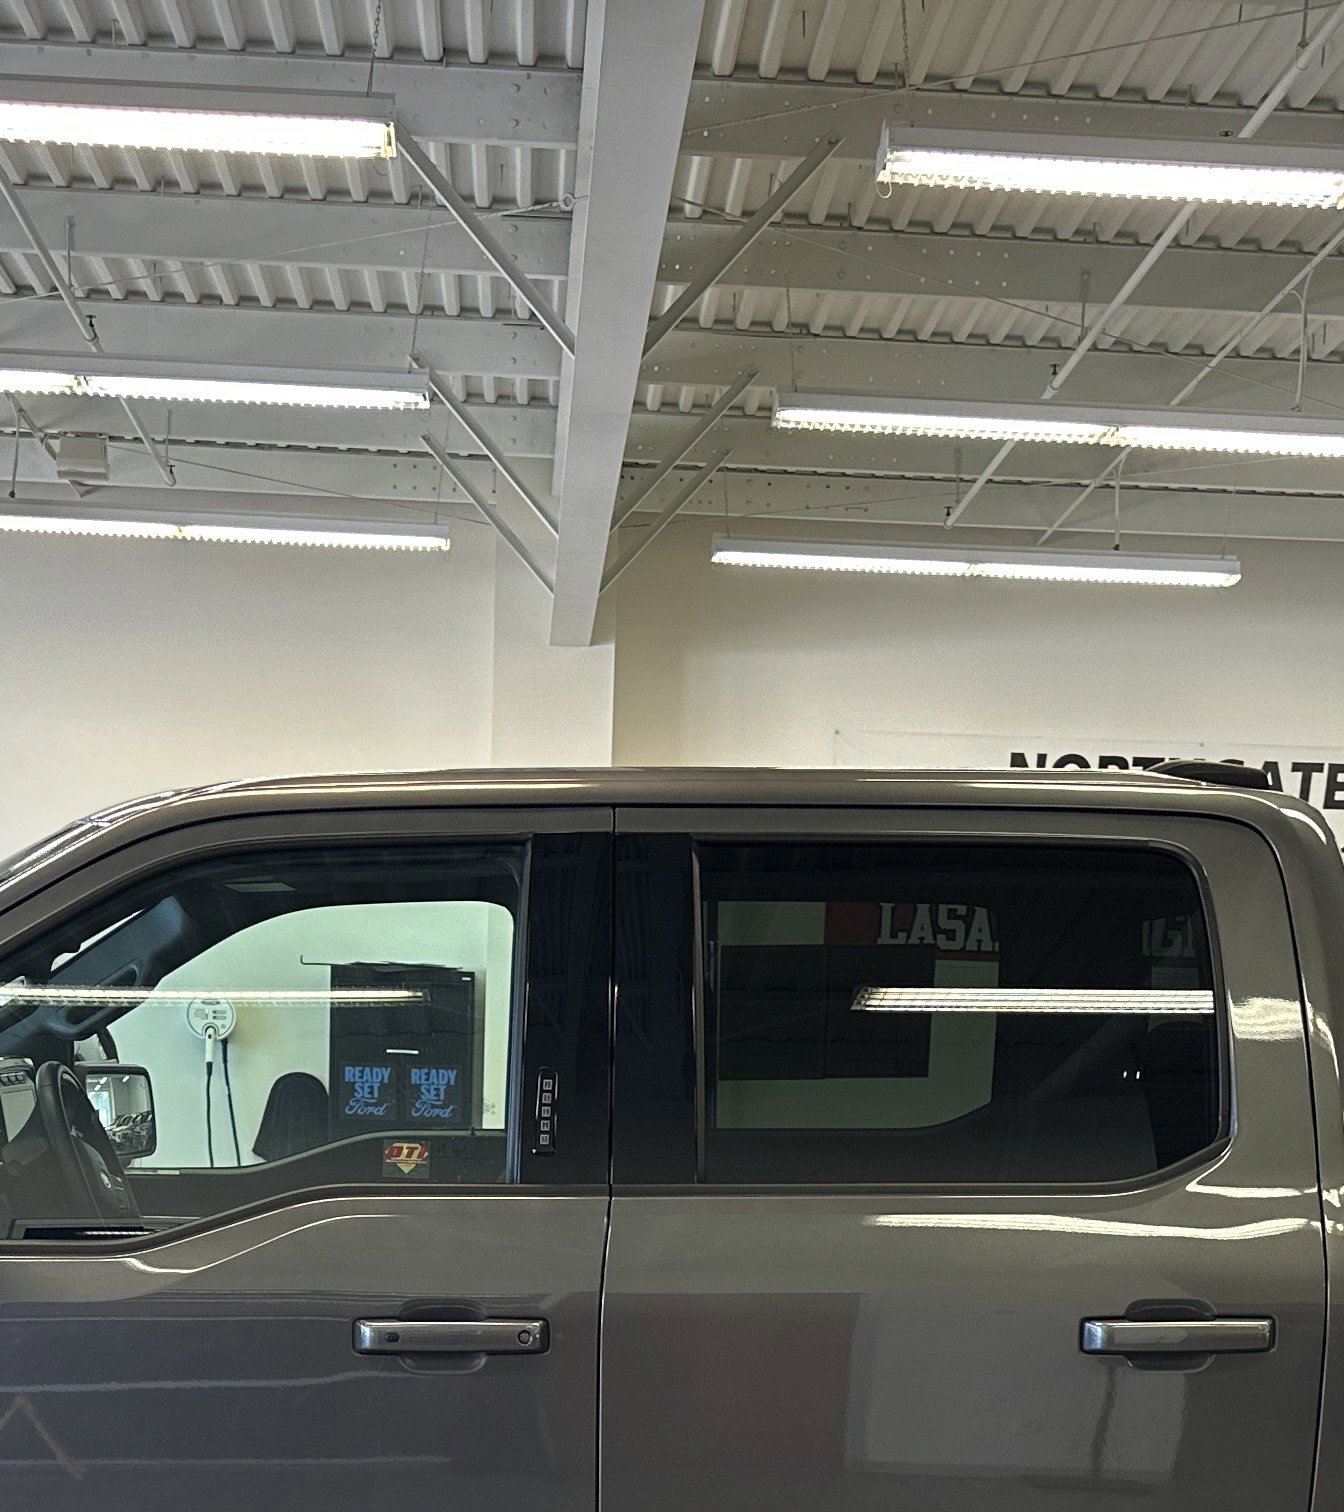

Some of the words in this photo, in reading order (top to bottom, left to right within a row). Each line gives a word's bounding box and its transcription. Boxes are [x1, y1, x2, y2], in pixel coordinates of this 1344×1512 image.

[877, 902, 1000, 952] LASA
[344, 1066, 391, 1084] READY
[410, 1068, 457, 1085] READY
[354, 1082, 381, 1098] SET
[420, 1084, 447, 1101] SET
[345, 1098, 390, 1116] Ford
[411, 1100, 455, 1118] Ford
